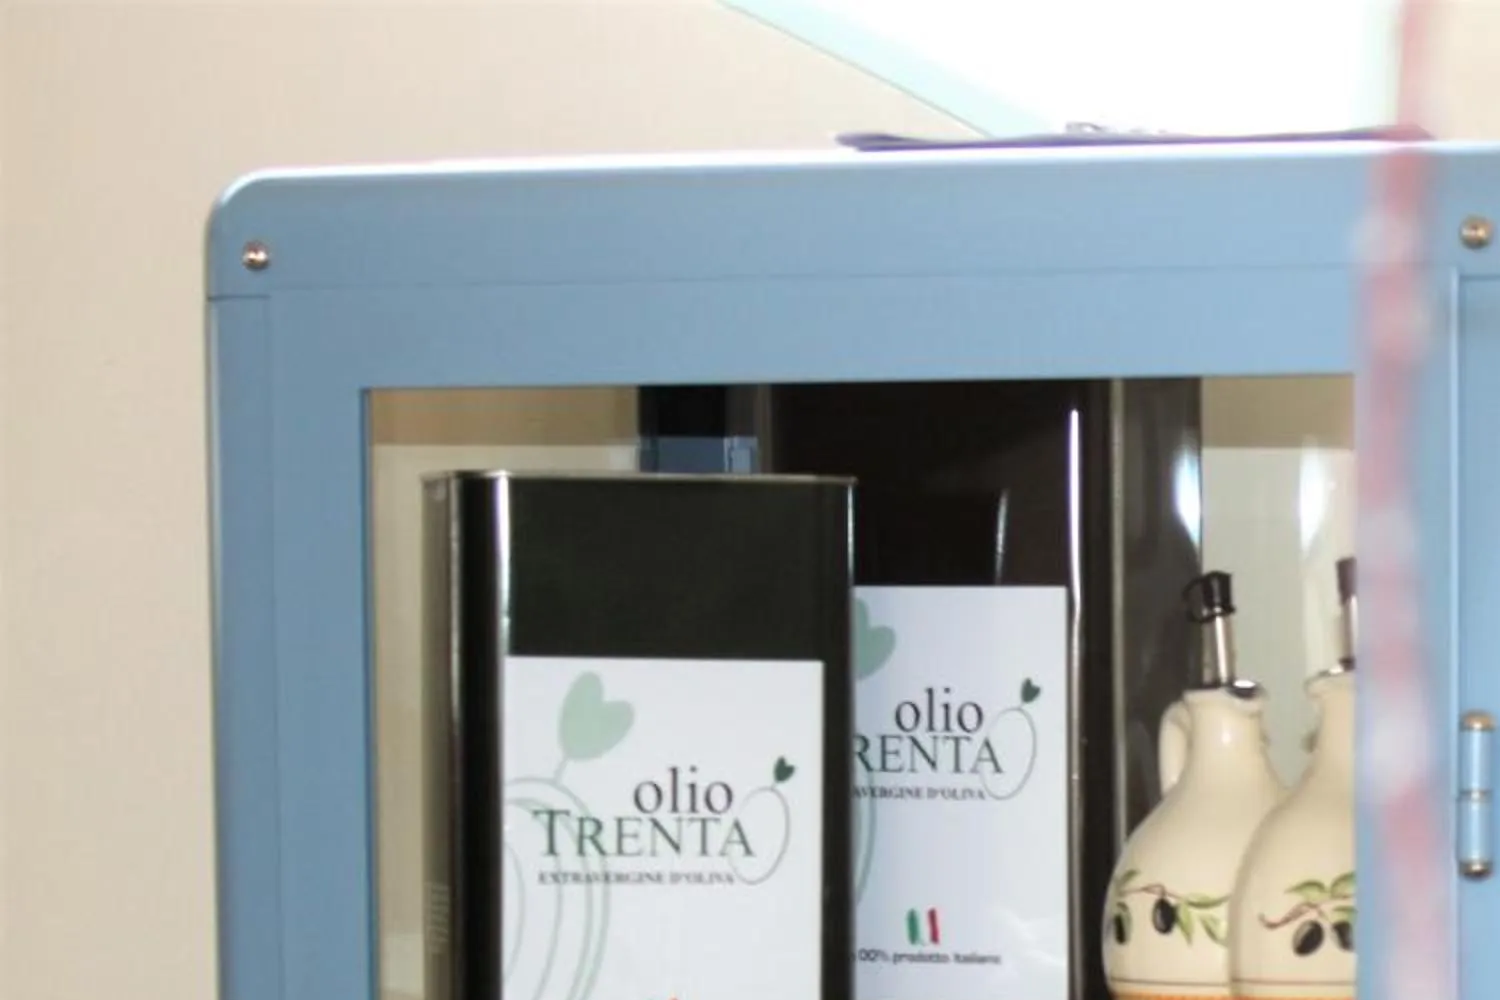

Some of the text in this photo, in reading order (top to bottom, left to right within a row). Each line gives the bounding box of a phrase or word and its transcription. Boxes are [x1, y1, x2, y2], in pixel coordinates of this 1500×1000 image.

[895, 686, 984, 734] olio
[853, 734, 1003, 774] RENTA
[633, 765, 734, 815] olio
[854, 786, 922, 800] AVERGINE
[531, 809, 755, 858] TRENTA
